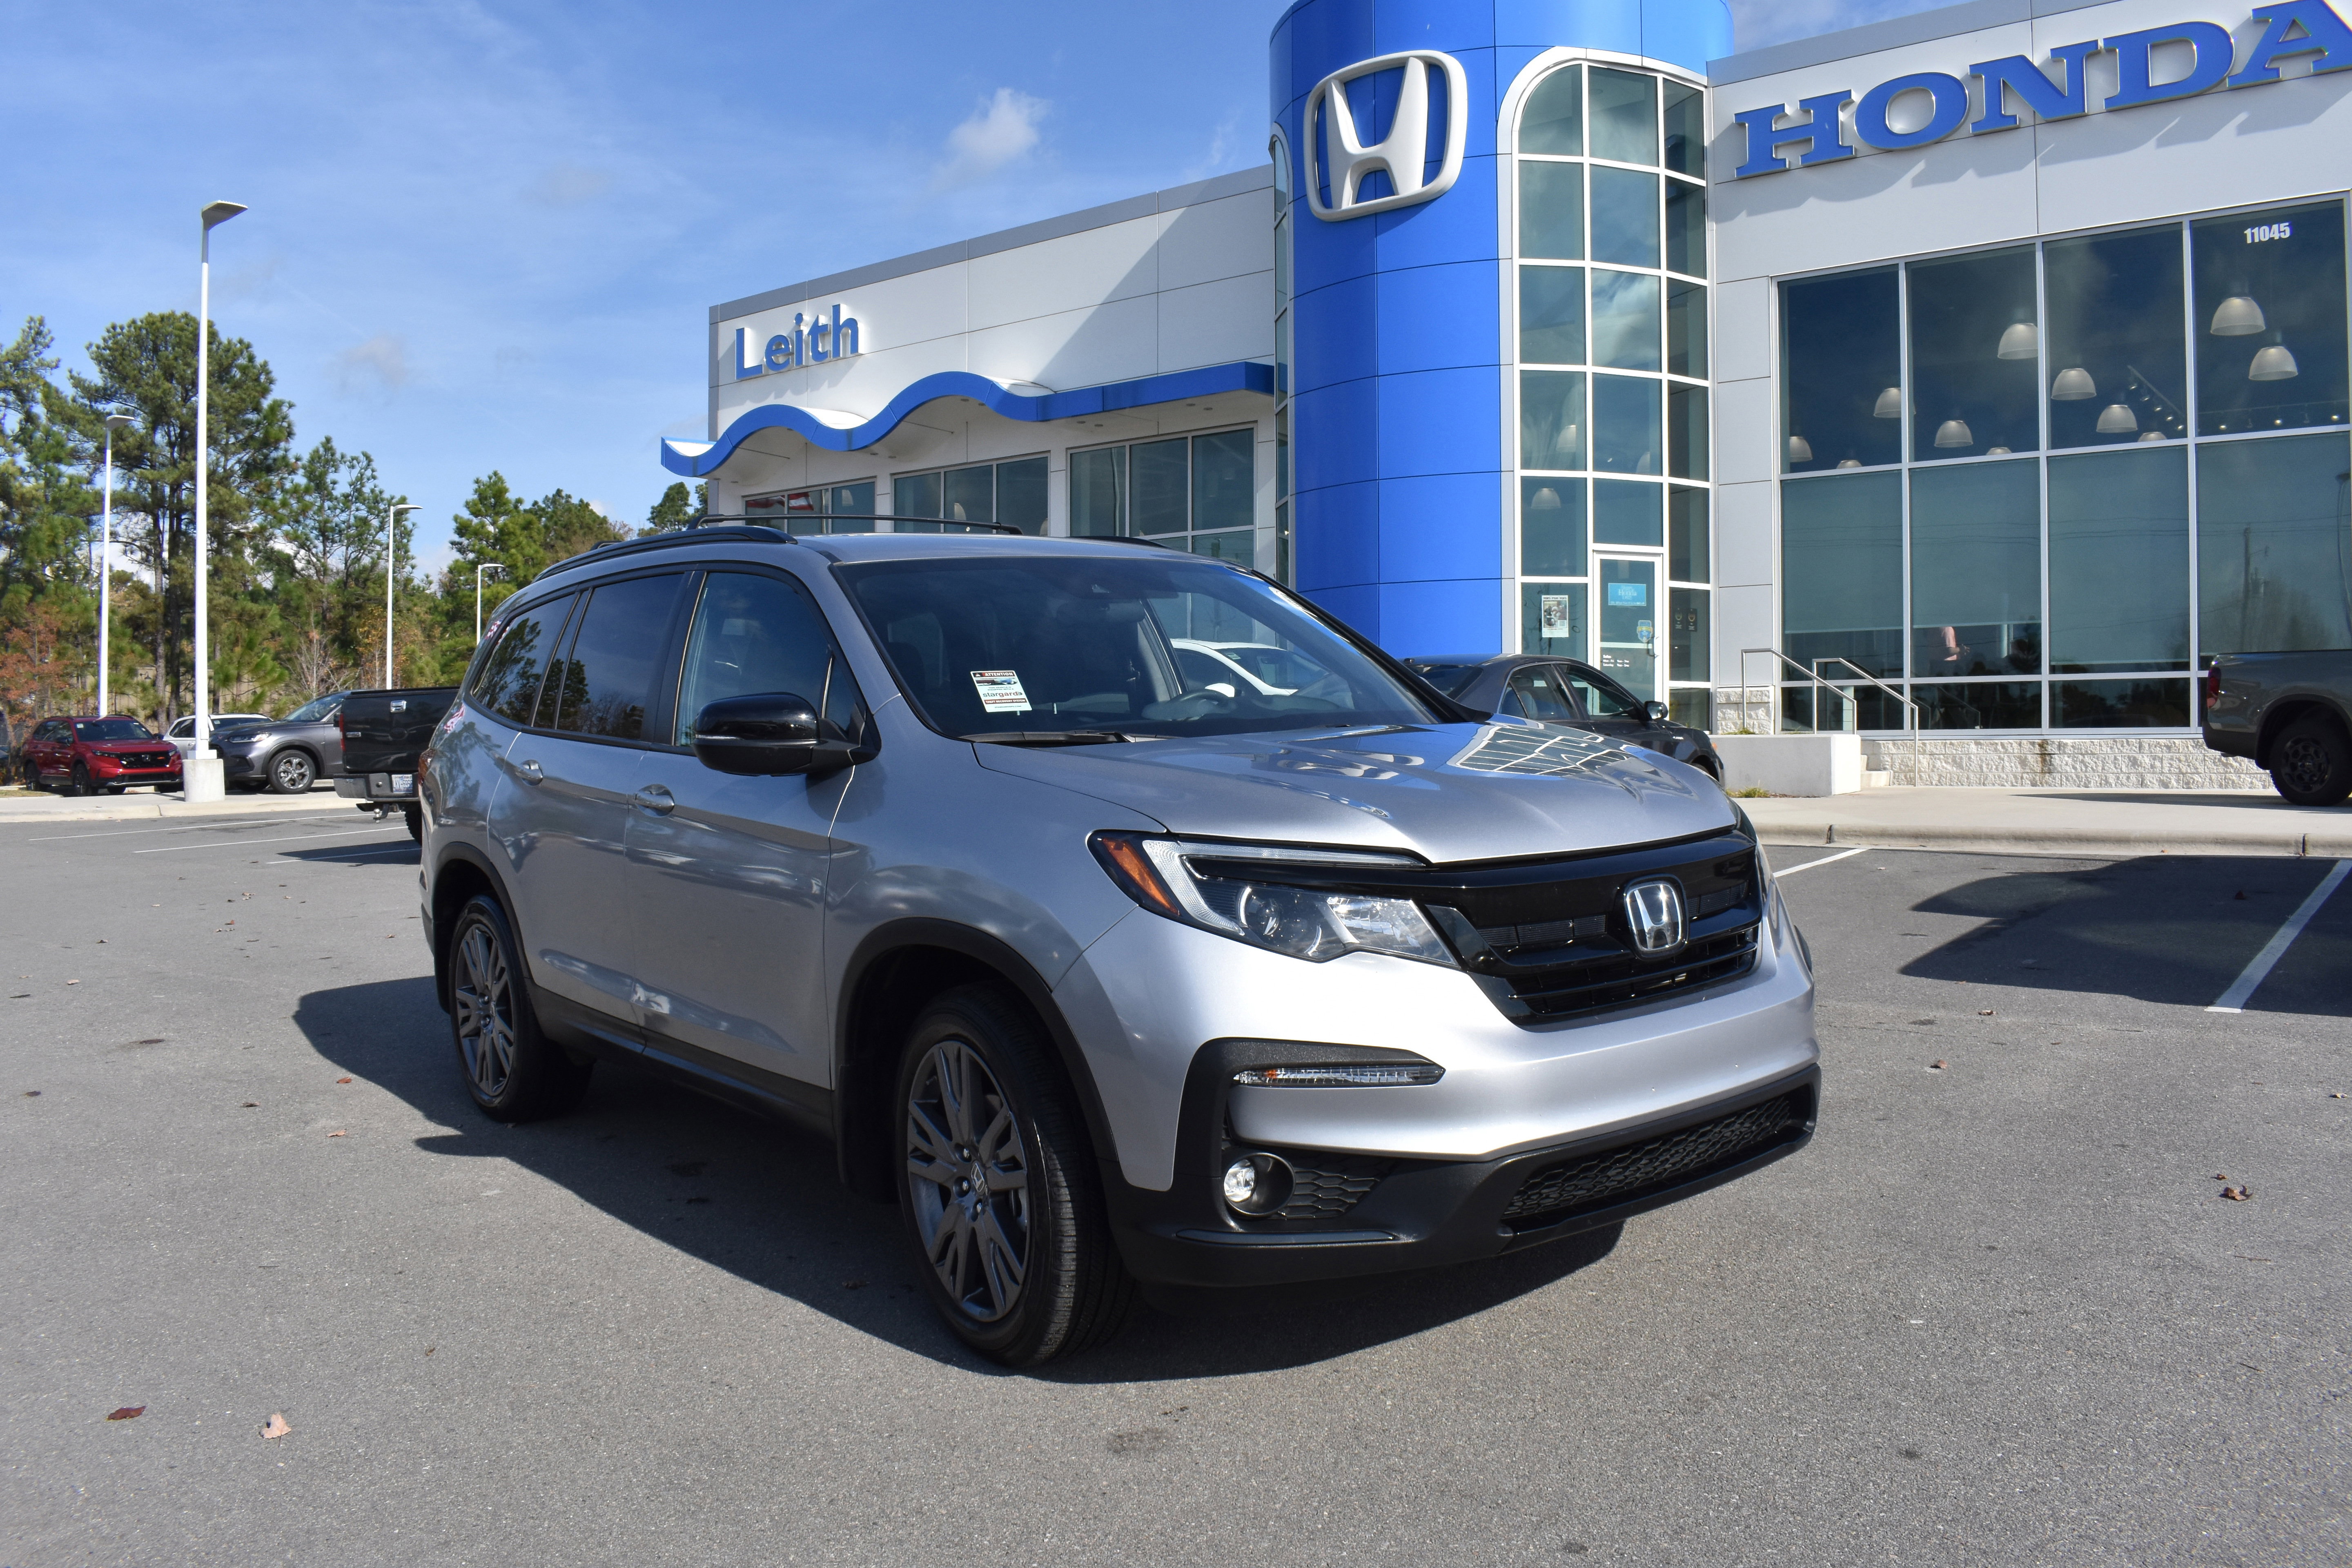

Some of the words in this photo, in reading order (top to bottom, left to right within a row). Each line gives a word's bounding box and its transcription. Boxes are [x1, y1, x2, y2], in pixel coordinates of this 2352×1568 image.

[1734, 0, 2352, 178] HONDA
[2244, 222, 2290, 244] 11045
[735, 303, 860, 380] Leith
